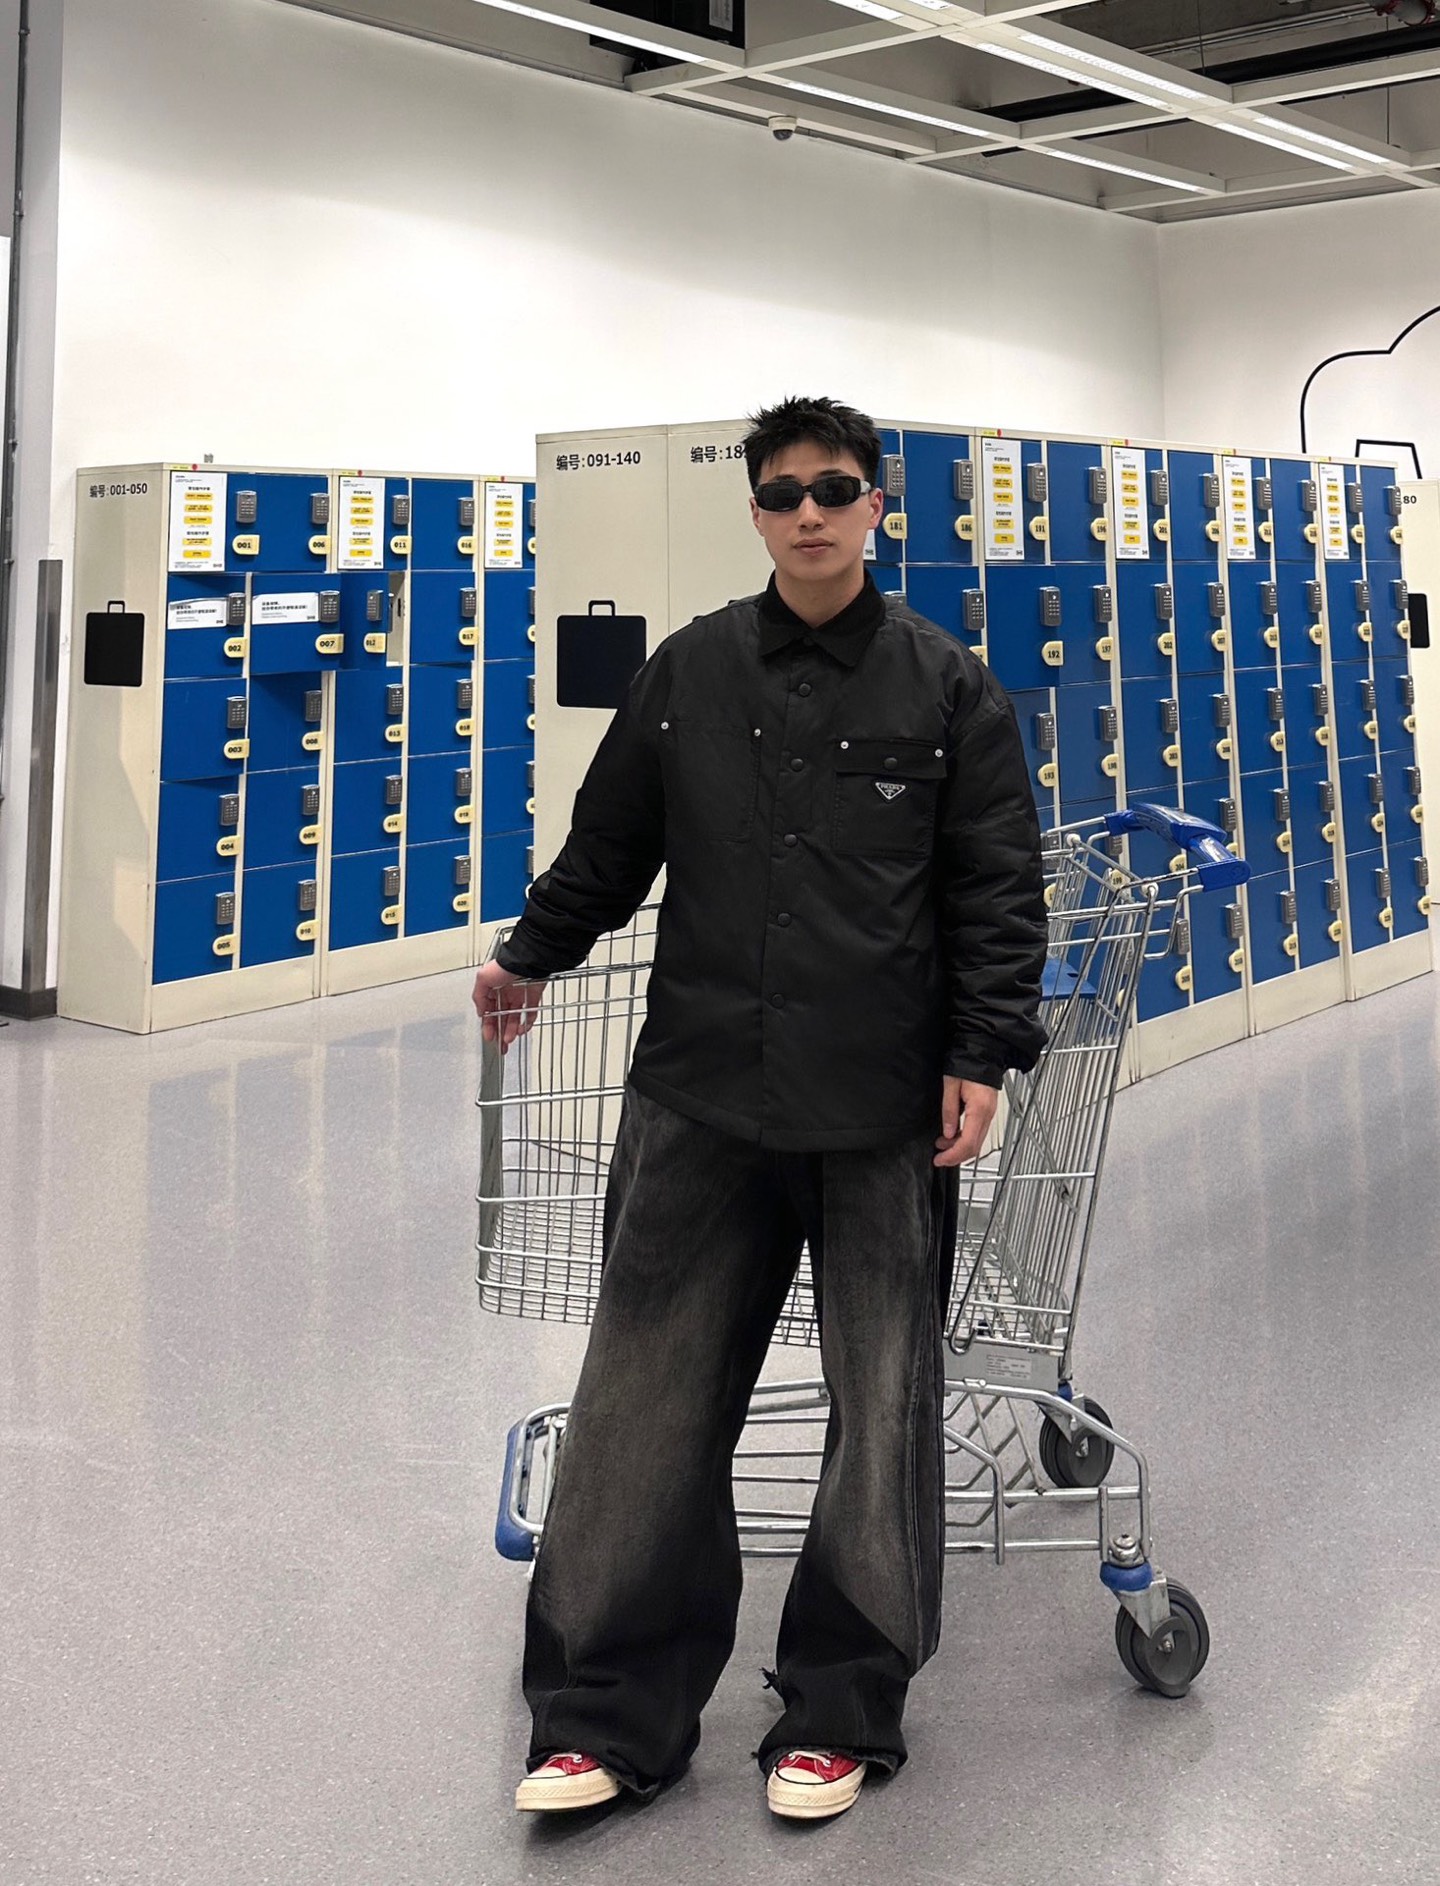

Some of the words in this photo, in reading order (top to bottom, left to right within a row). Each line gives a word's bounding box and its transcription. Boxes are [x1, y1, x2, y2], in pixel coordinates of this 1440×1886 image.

[690, 445, 748, 464] 编号:18
[556, 450, 641, 471] 编号:091-140
[90, 482, 148, 498] 编号:001-050
[1402, 495, 1417, 505] 80
[890, 522, 903, 531] 181
[320, 640, 335, 648] 007
[228, 645, 242, 653] 002
[1048, 650, 1060, 659] 192
[228, 746, 242, 754] 003
